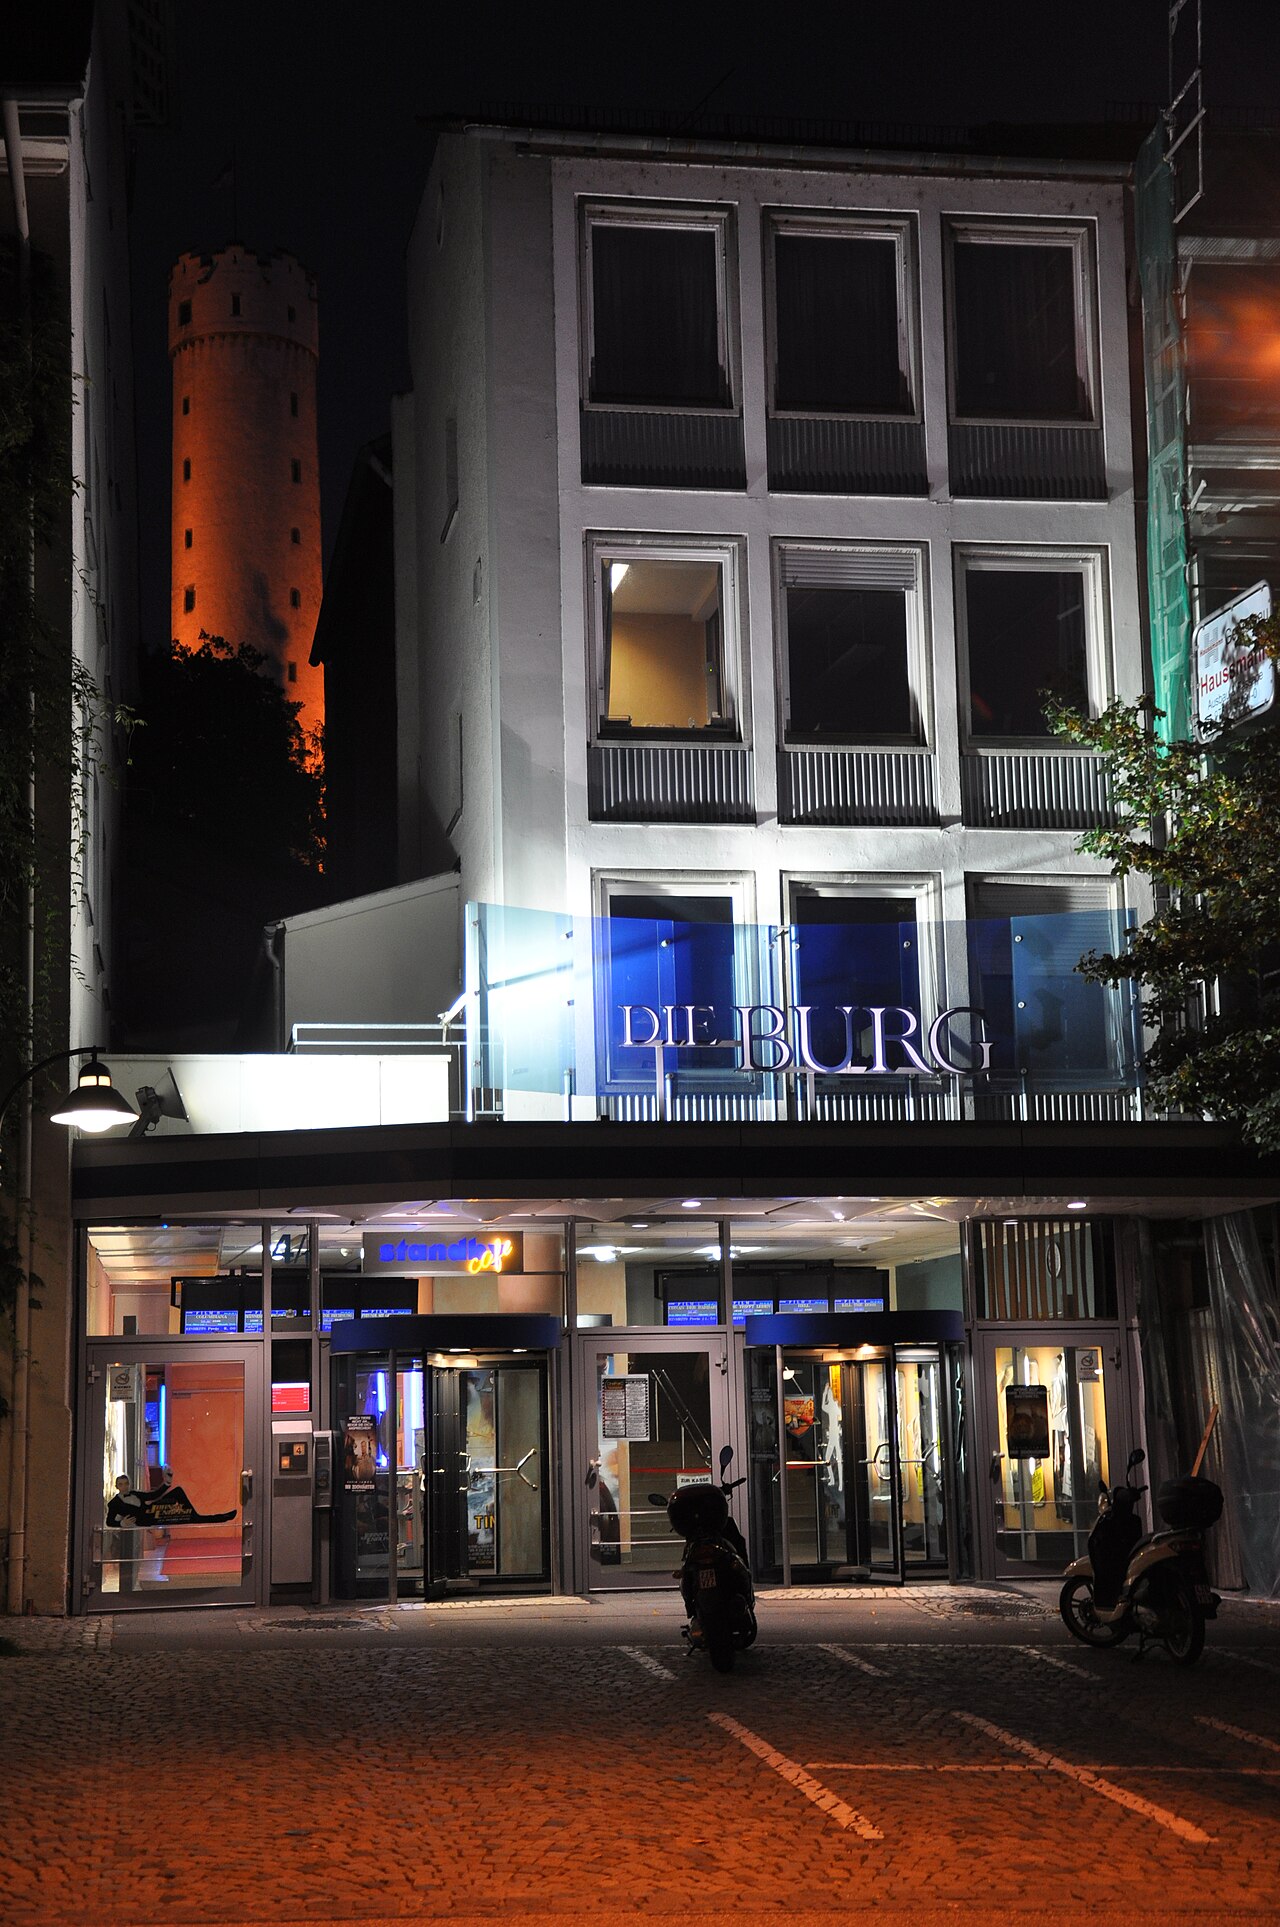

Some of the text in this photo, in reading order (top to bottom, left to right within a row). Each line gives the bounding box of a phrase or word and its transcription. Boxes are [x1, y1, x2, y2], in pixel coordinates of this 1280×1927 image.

[619, 1004, 999, 1077] DIE BURG
[379, 1237, 504, 1265] standby
